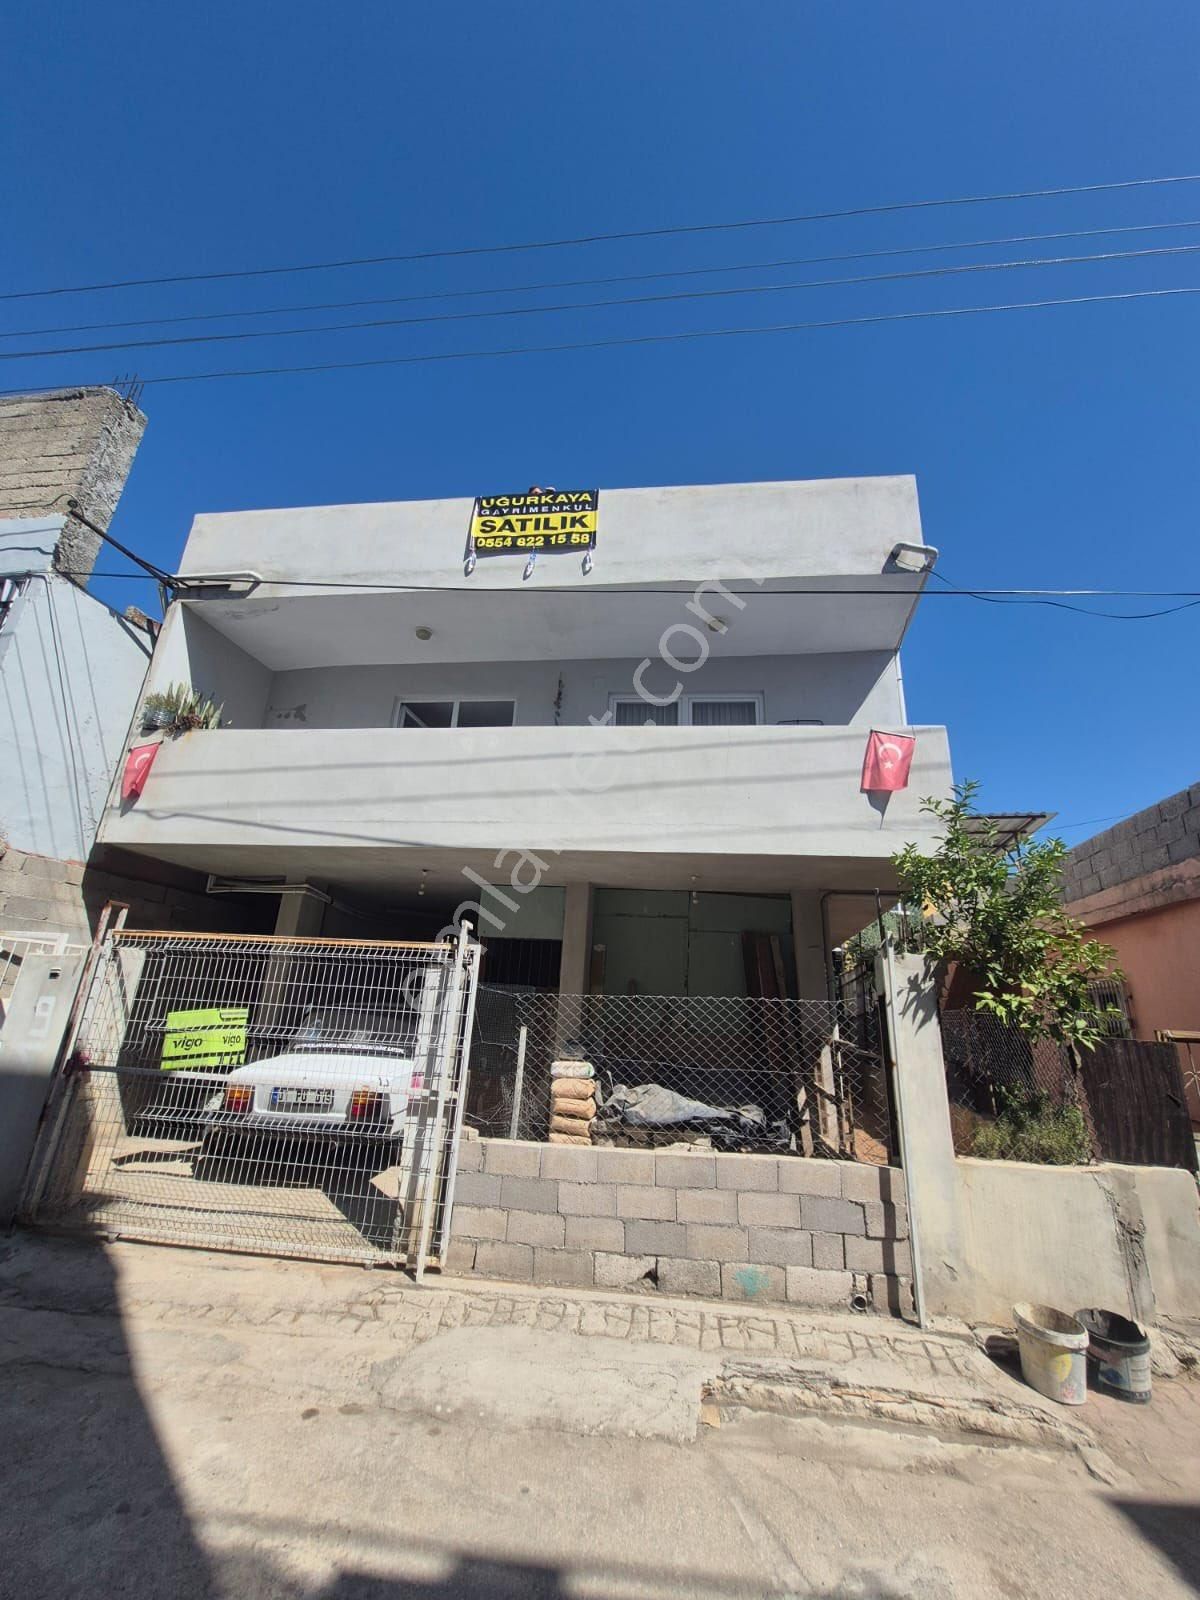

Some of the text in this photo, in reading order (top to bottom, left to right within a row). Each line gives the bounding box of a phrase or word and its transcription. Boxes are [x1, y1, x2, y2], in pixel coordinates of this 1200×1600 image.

[480, 515, 589, 533] SATILIK
[477, 537, 512, 548] 0554
[550, 534, 566, 545] 15
[570, 533, 590, 544] 58
[173, 1032, 241, 1051] vigo vigo
